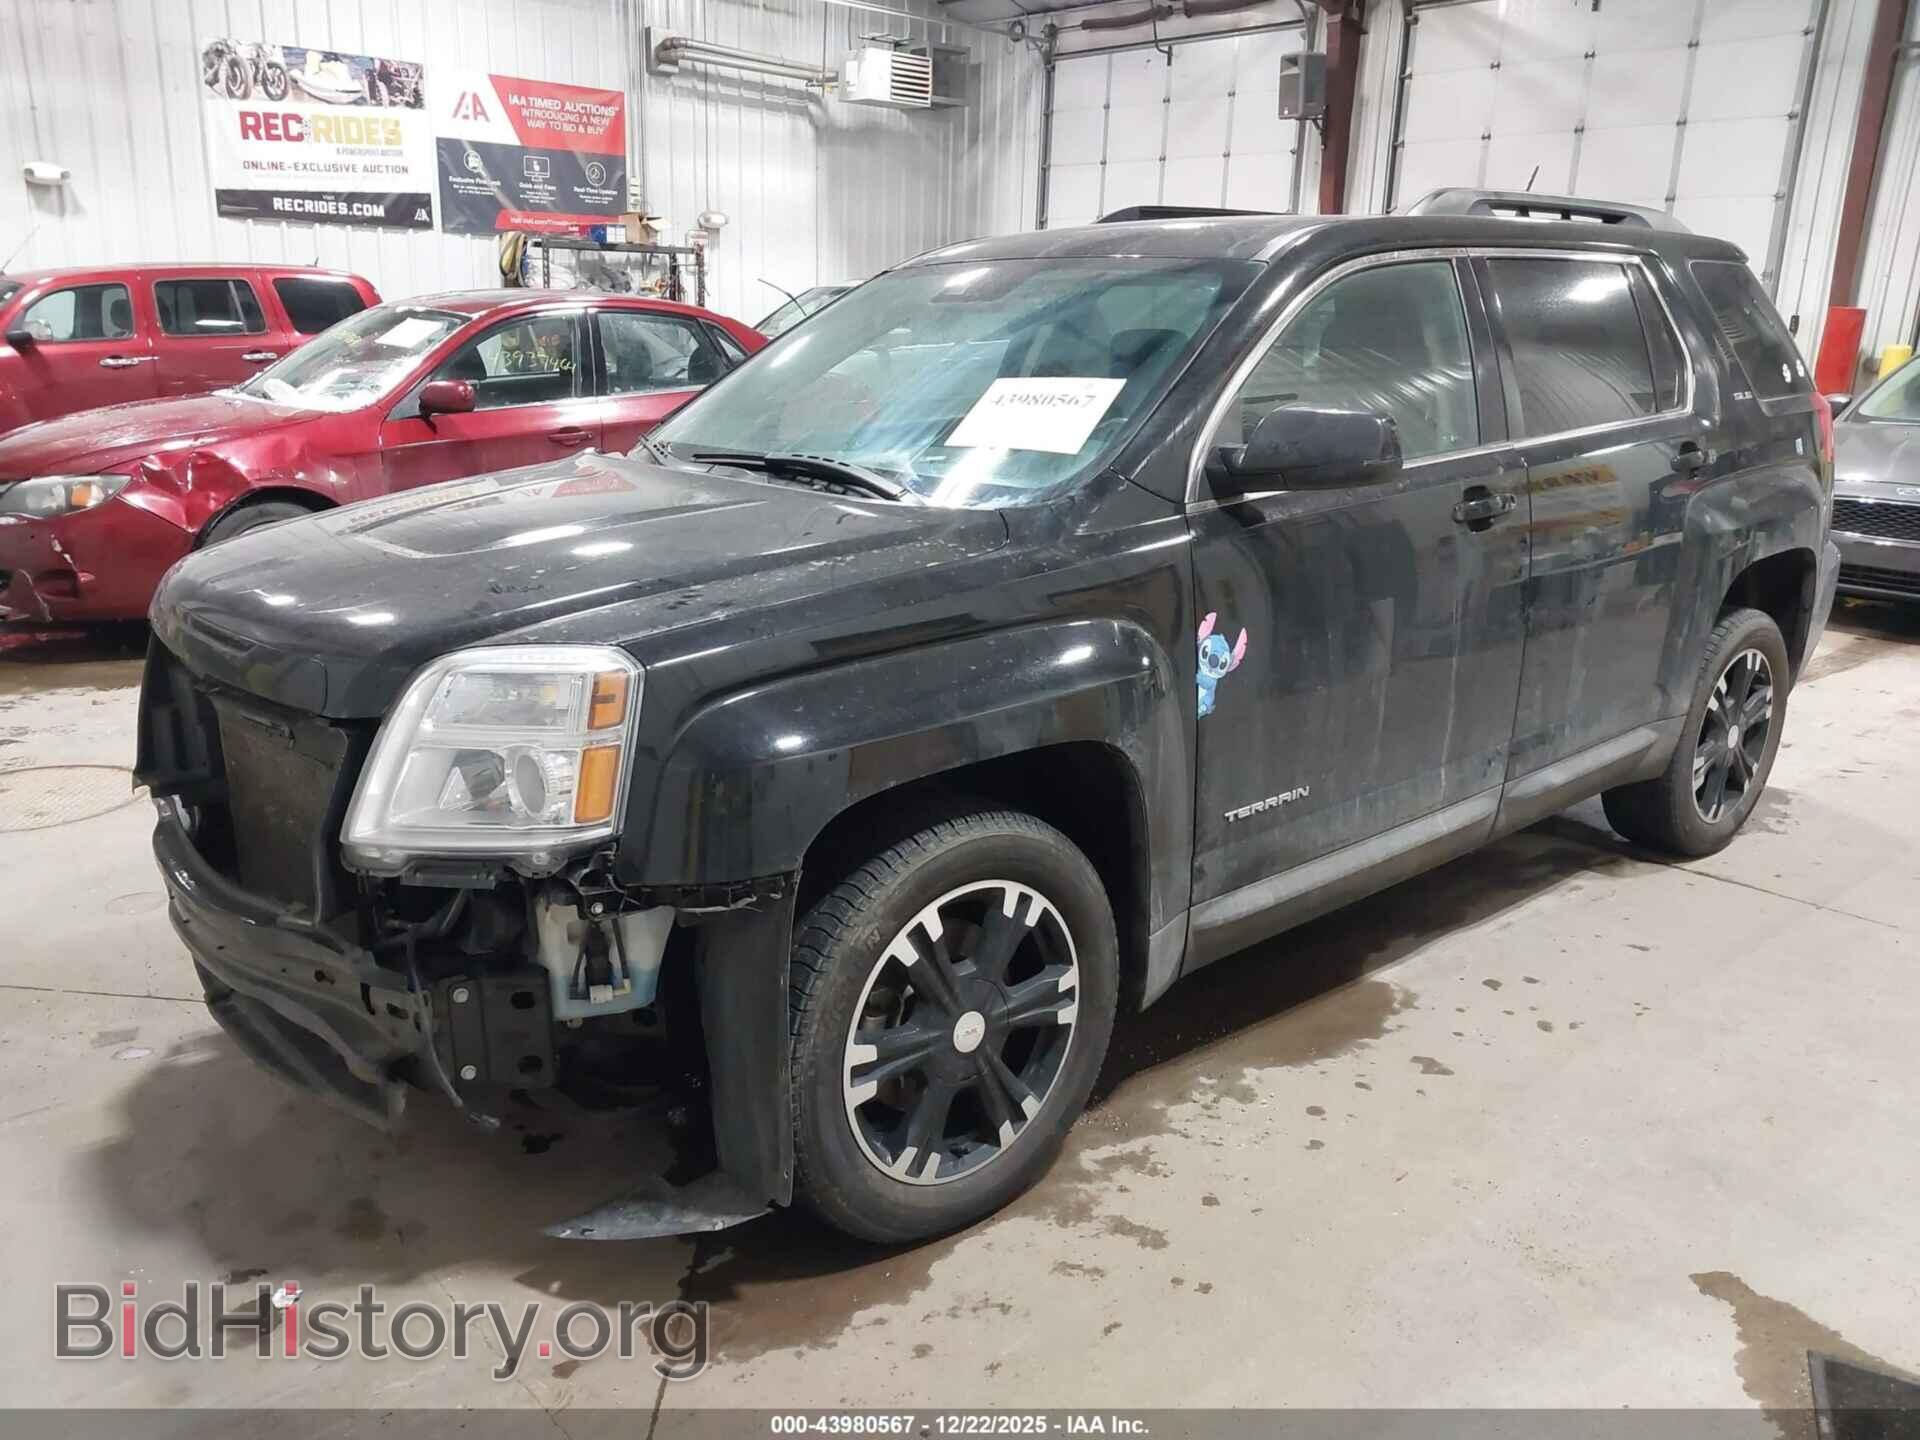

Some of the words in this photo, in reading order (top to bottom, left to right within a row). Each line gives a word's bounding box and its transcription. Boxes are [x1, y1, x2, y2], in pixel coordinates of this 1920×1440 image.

[507, 94, 527, 107] IAA
[529, 96, 561, 111] TIMED
[521, 107, 580, 124] INTRODUCING
[582, 113, 590, 124] A
[590, 114, 611, 127] NEW
[526, 118, 546, 130] WAY
[548, 121, 562, 132] TO
[562, 122, 577, 134] BID
[578, 124, 586, 135] &
[586, 125, 605, 136] BUY
[242, 160, 358, 174] ONLINE-EXCLUSIVE
[362, 163, 409, 175] AUCTION
[272, 197, 385, 217] RECRIDES.COM
[991, 391, 1097, 409] 43980567
[1223, 785, 1311, 823] TERRAIN
